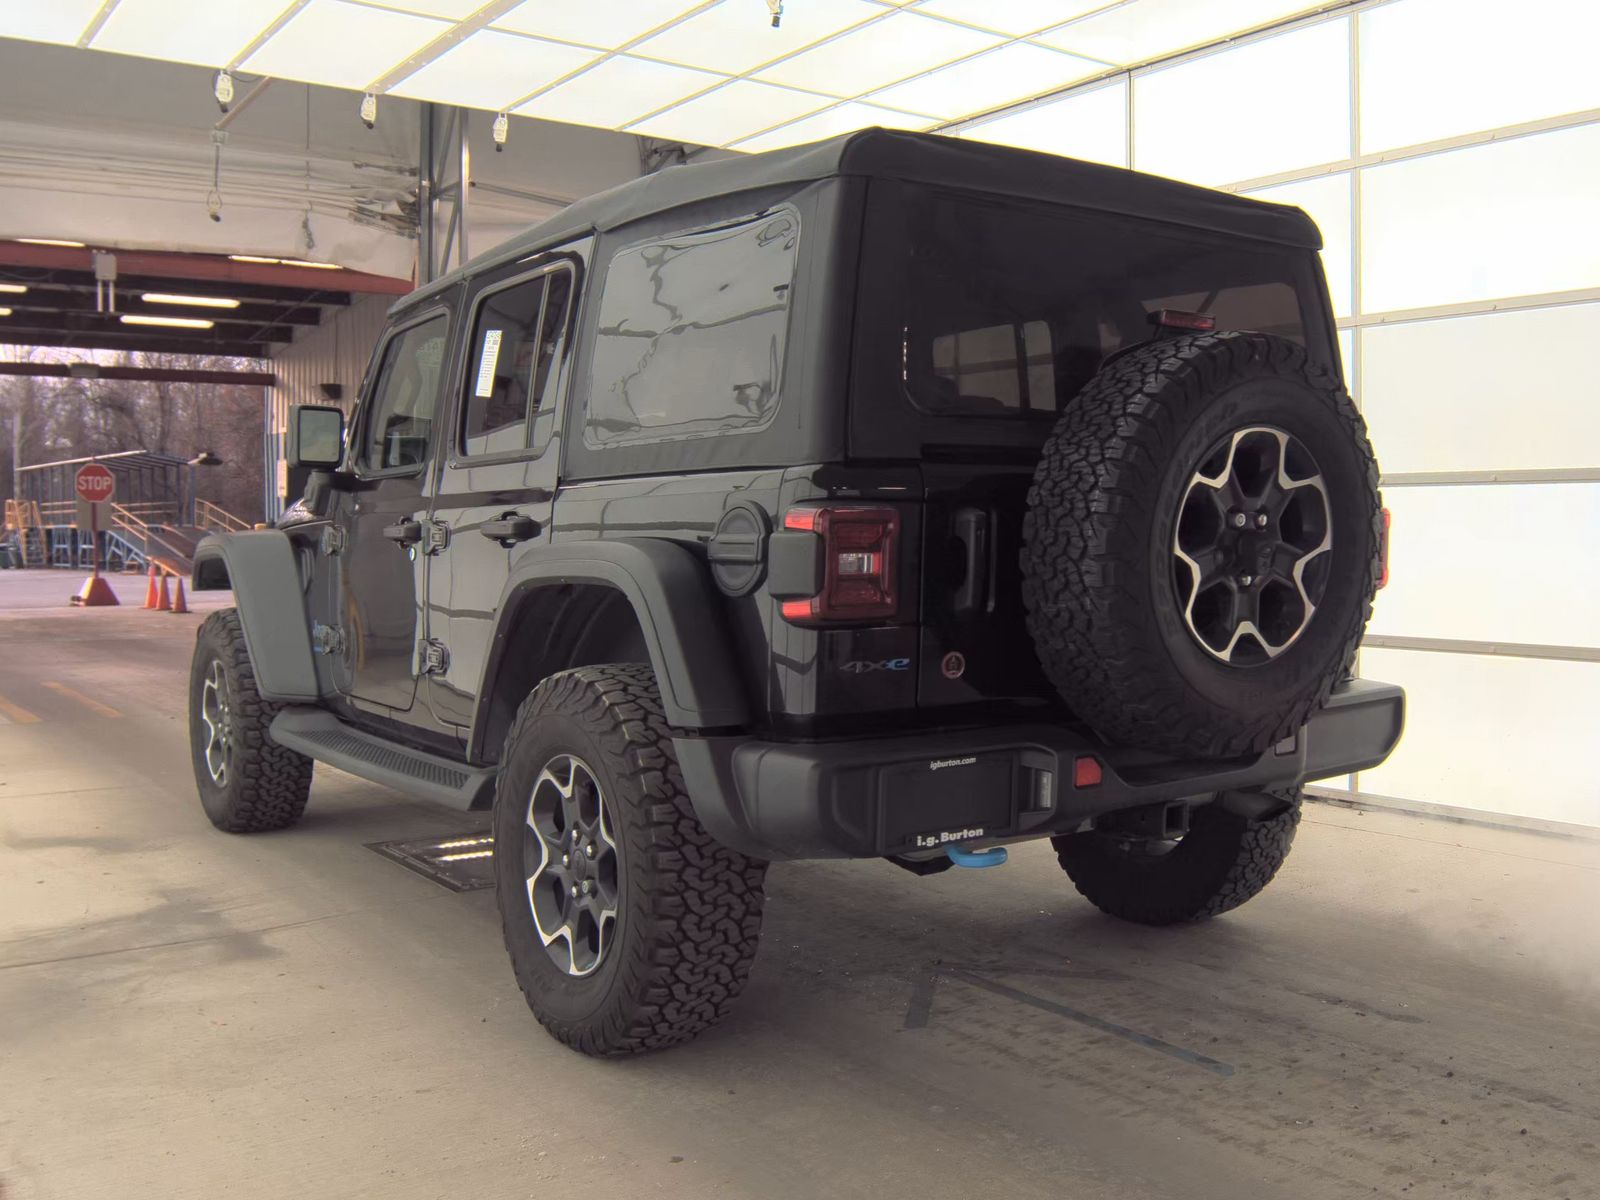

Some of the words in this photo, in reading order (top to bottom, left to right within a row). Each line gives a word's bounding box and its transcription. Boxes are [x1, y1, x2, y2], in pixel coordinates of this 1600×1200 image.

[78, 476, 112, 491] STOP
[930, 757, 977, 771] igburton.com
[940, 828, 984, 842] Burton
